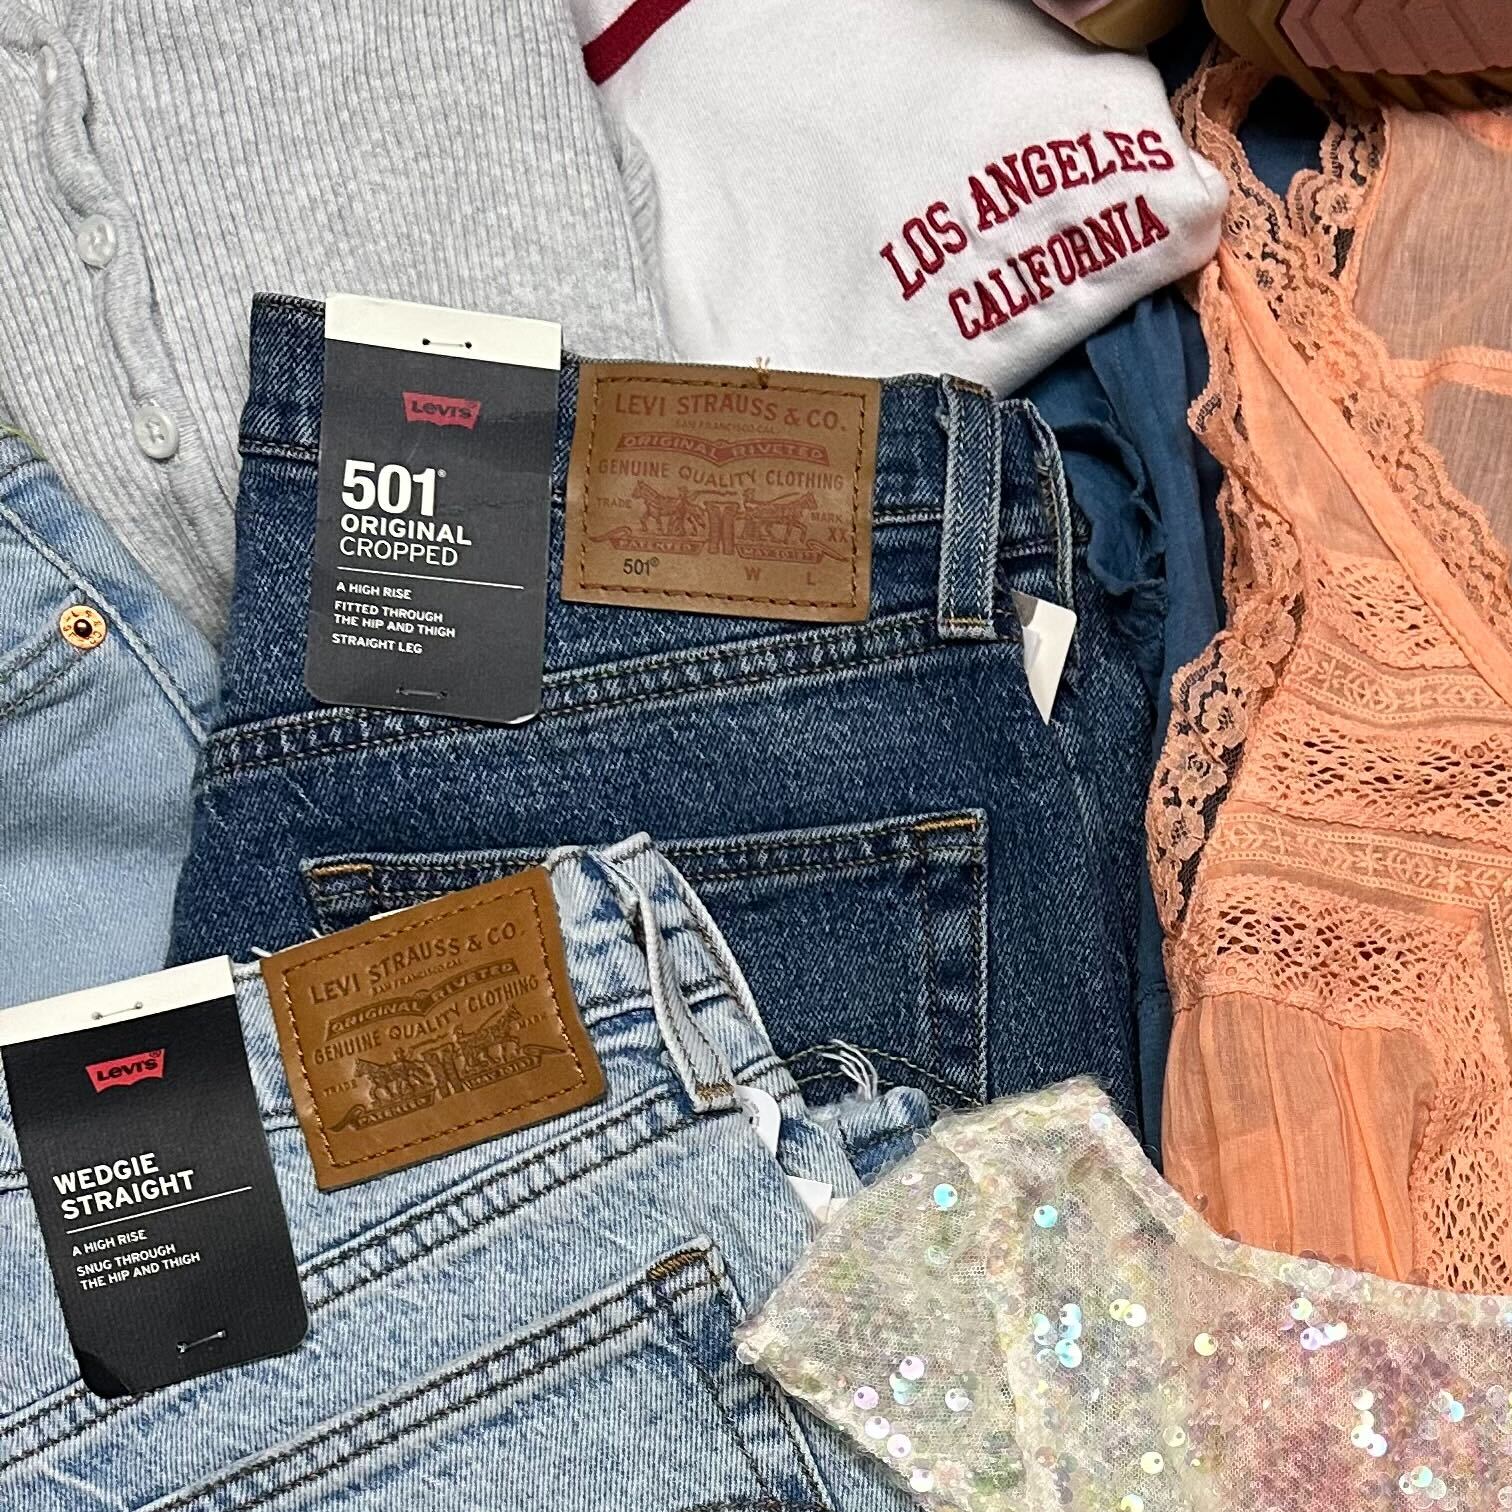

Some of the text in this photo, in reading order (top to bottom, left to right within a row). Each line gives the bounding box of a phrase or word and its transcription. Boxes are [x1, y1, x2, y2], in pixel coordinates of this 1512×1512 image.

[880, 129, 1174, 300] LOS ANGELES
[949, 194, 1170, 340] CALIFORNIA
[616, 393, 848, 431] LEVI STRAUSS & CO.
[624, 435, 719, 459] ORIGINAL
[599, 459, 845, 490] GENUINE QUALITY CLOTHING
[340, 513, 472, 546] ORIGINAL
[339, 535, 458, 567] CROPPED
[336, 582, 412, 600] A HIGH RISE
[744, 566, 760, 581] W
[806, 572, 816, 586] L
[333, 613, 456, 638] THE HIP AND THIGH
[334, 601, 443, 623] FITTED THROUGH
[332, 633, 423, 655] STRAIGHT LEG
[309, 973, 361, 1005] LEVI
[368, 937, 460, 985] STRAUSS
[467, 934, 482, 951] &
[313, 974, 539, 1065] GENUINE QUALITY CLOTHING
[331, 1001, 422, 1034] ORIGINAL
[53, 1152, 159, 1195] WEDGIE
[61, 1169, 195, 1221] STRAIGHT
[72, 1229, 148, 1257] A HIGH RISE
[76, 1243, 177, 1277] SNUG THROUGH
[80, 1252, 201, 1291] THE HIP AND THIGH
